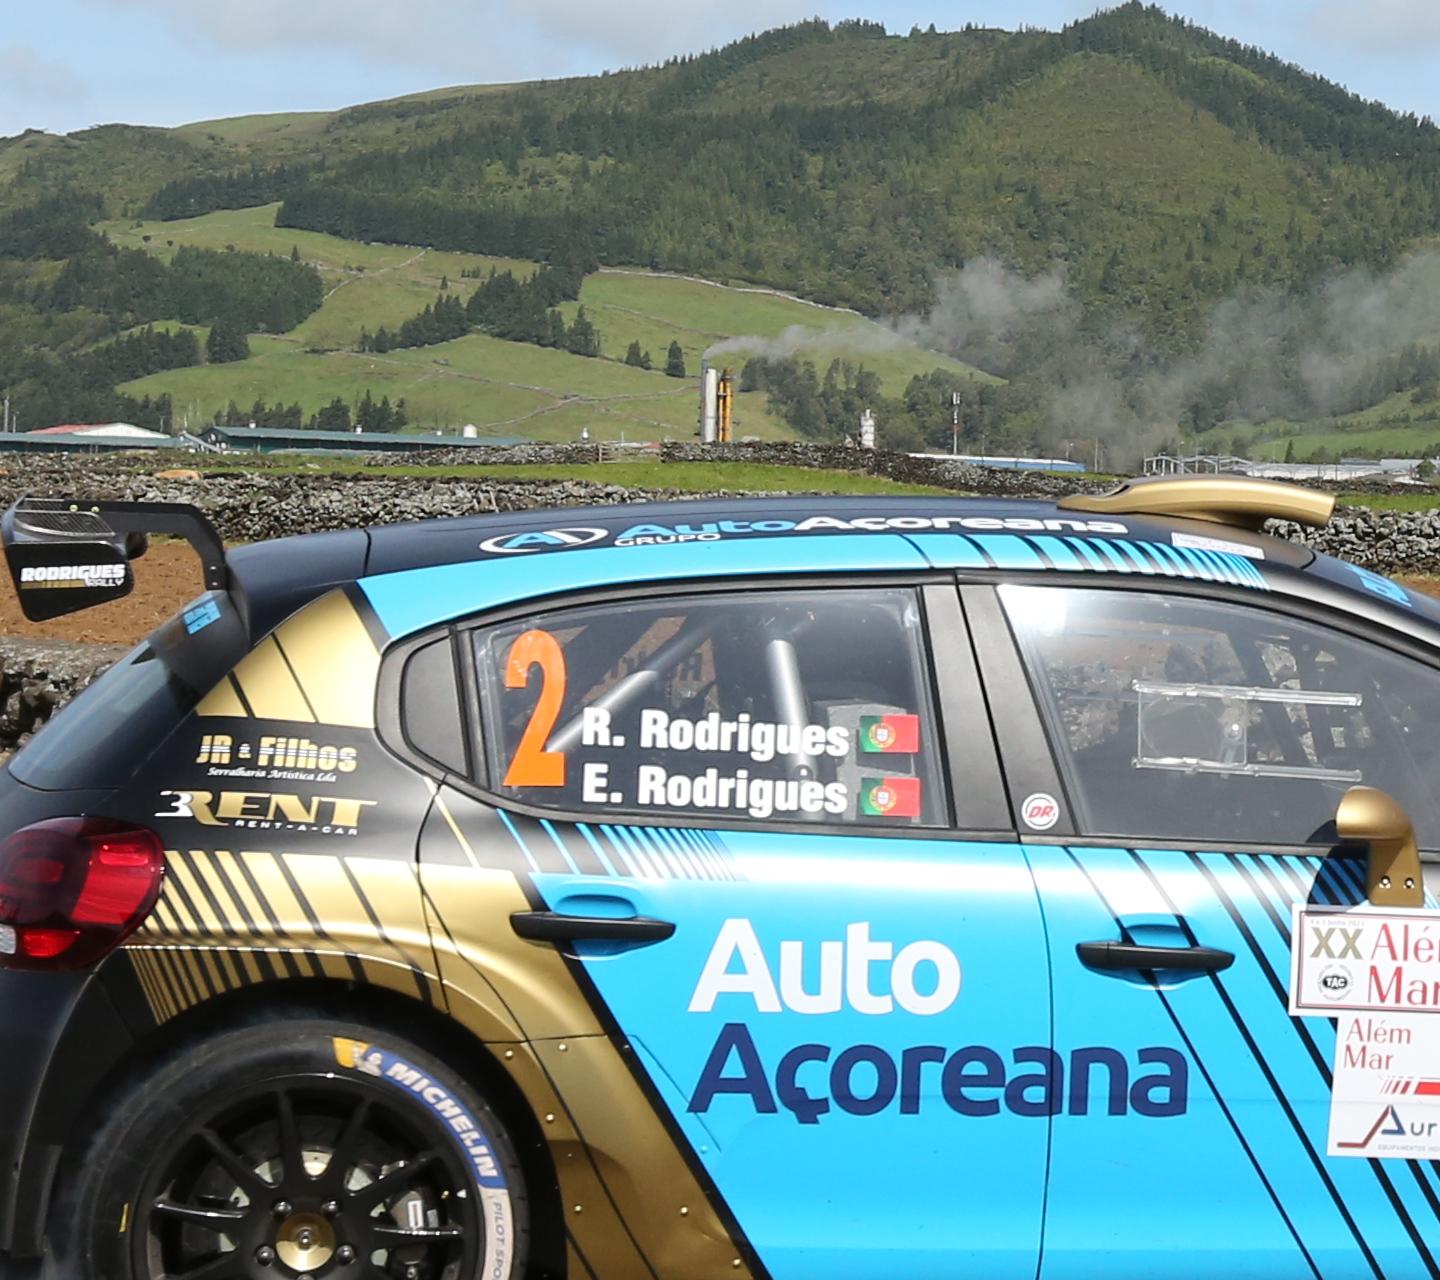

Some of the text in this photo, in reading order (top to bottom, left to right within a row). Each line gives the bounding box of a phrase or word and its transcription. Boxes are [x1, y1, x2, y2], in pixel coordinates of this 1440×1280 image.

[614, 533, 721, 547] GRUPO
[21, 564, 125, 582] RODRIGUES
[503, 629, 567, 787] 2
[582, 707, 850, 762] R. Rodrigues
[196, 735, 232, 764] JR
[257, 736, 357, 772] Filhos
[582, 763, 849, 818] E. Rodrigues
[235, 819, 358, 836] RENT-A-CAR
[1309, 927, 1364, 960] XX
[687, 918, 962, 1016] Auto
[1325, 977, 1345, 988] TAC
[1346, 1017, 1411, 1044] Além
[686, 1022, 1189, 1125] Açoreana
[1344, 1044, 1394, 1070] Mar
[384, 1062, 498, 1177] MICHELIN
[493, 1202, 505, 1246] PILOT
